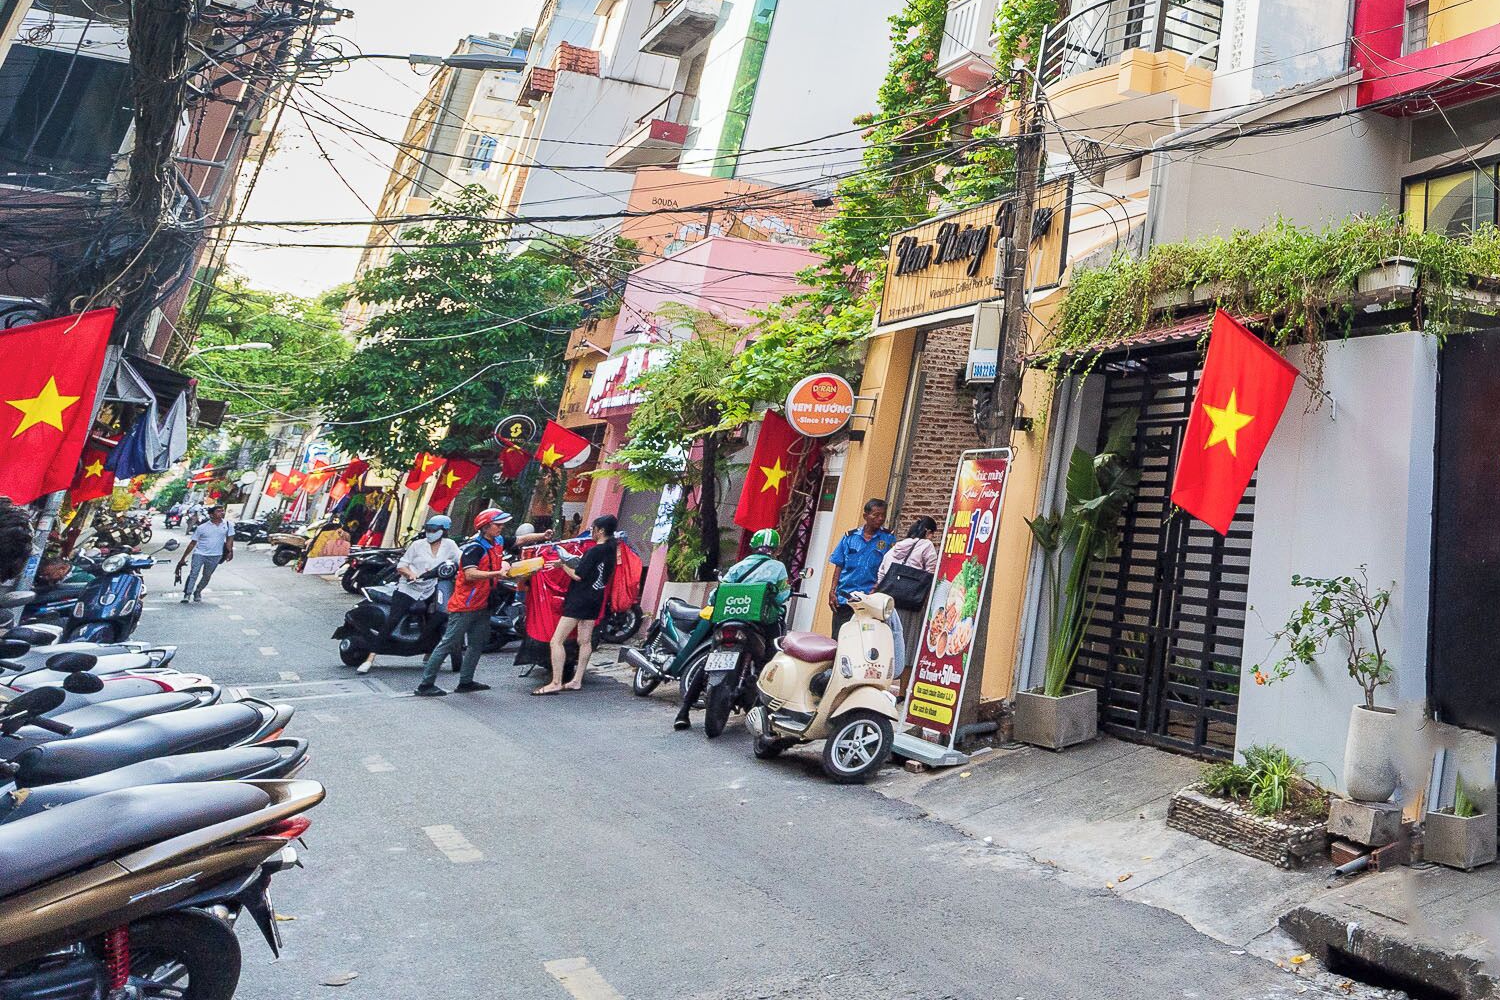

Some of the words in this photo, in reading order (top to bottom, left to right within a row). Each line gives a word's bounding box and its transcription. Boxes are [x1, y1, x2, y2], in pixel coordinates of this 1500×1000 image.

[965, 508, 981, 556] 1
[725, 594, 752, 606] Grab
[723, 604, 750, 616] Food
